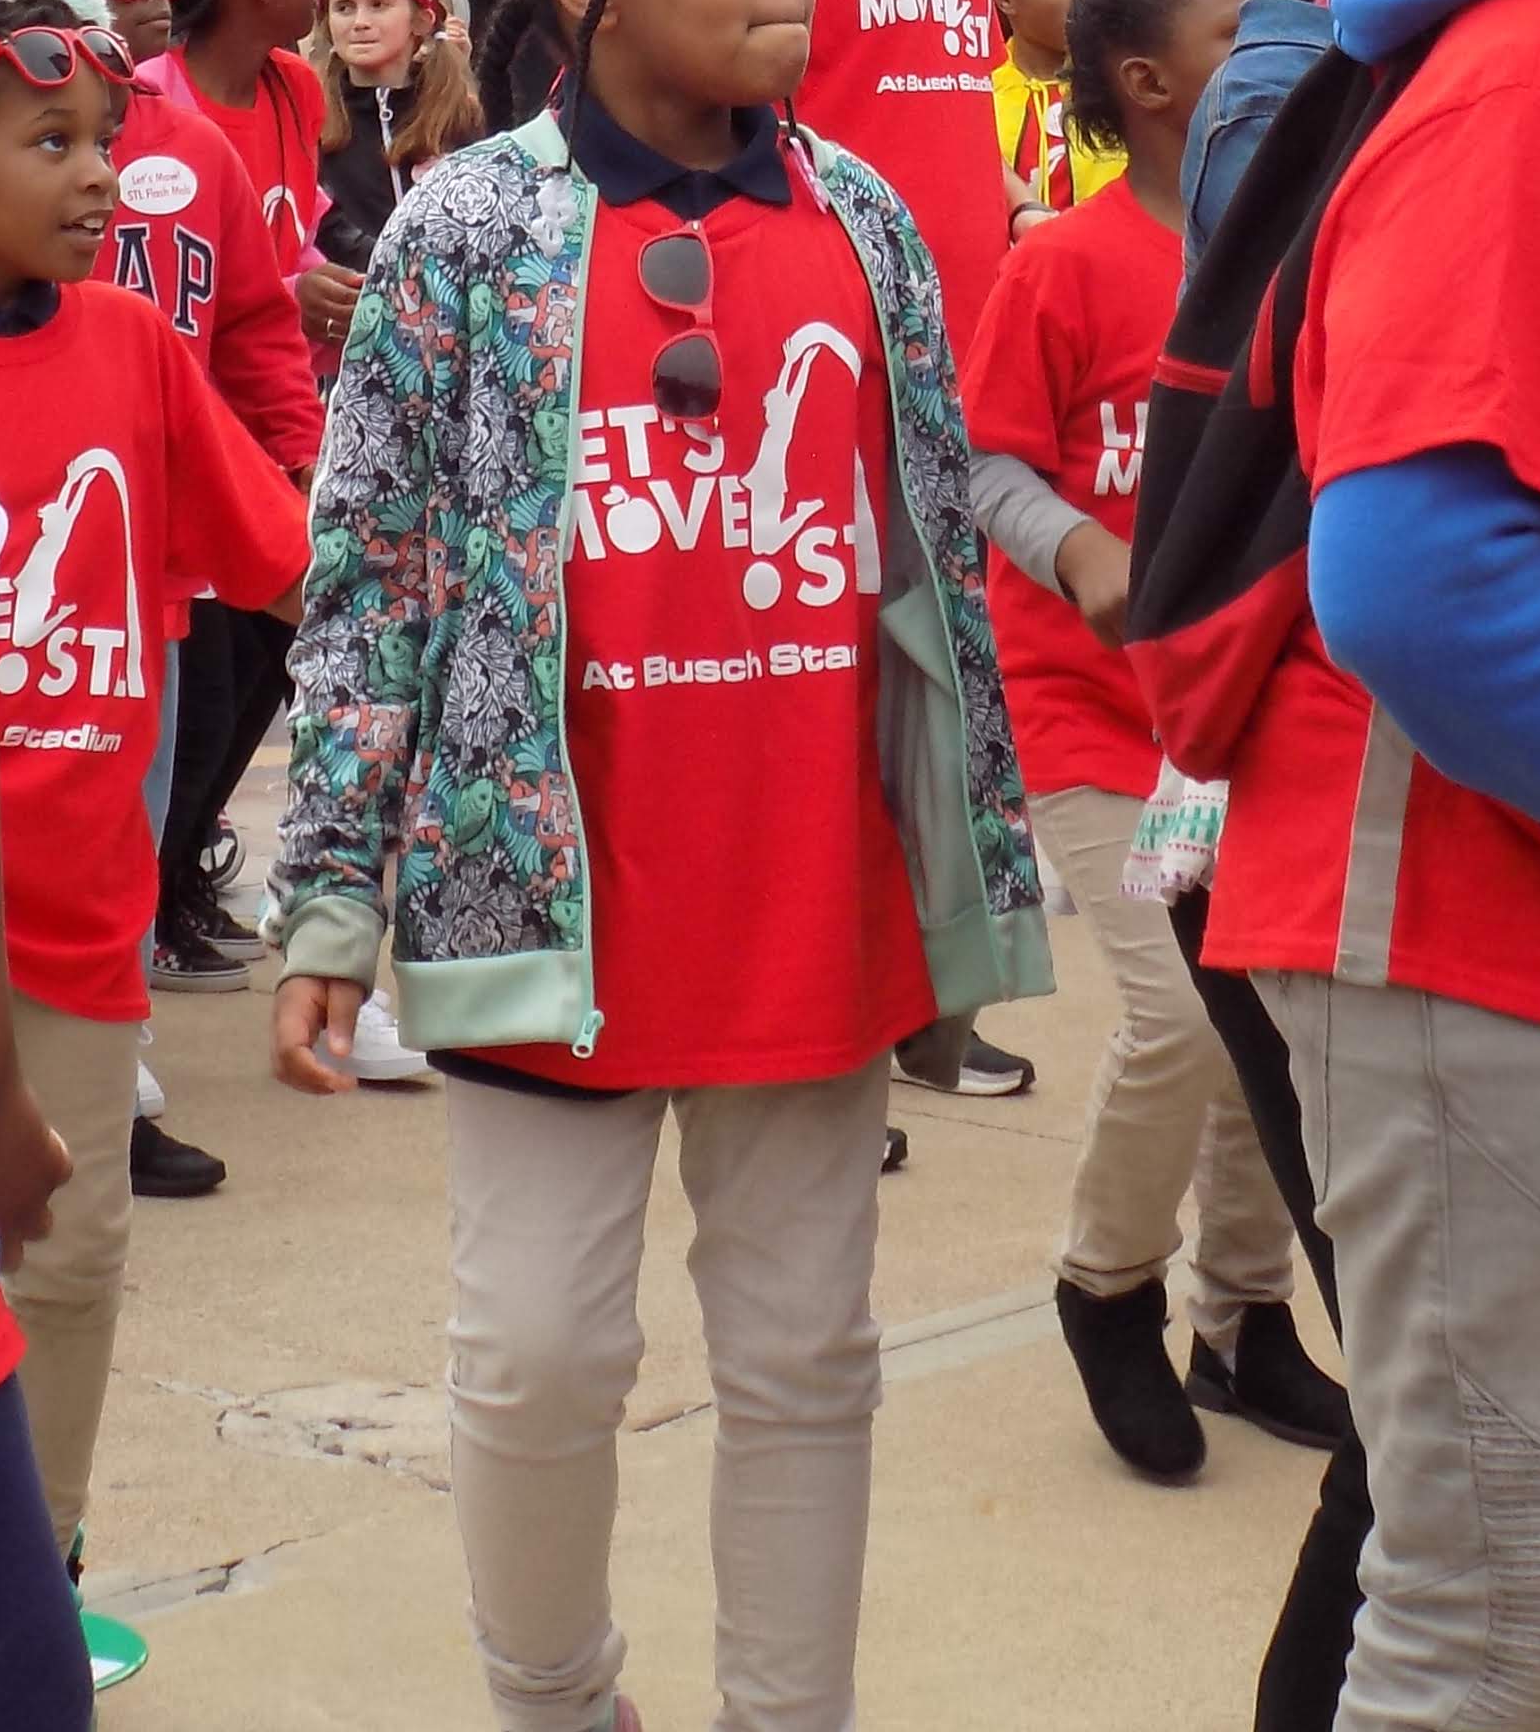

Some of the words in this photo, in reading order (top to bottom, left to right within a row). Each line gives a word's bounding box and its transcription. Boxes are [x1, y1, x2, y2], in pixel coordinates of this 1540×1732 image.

[876, 75, 906, 94] At
[906, 73, 958, 93] Busch
[114, 222, 216, 338] AP
[582, 660, 636, 691] At
[643, 650, 763, 689] Busch
